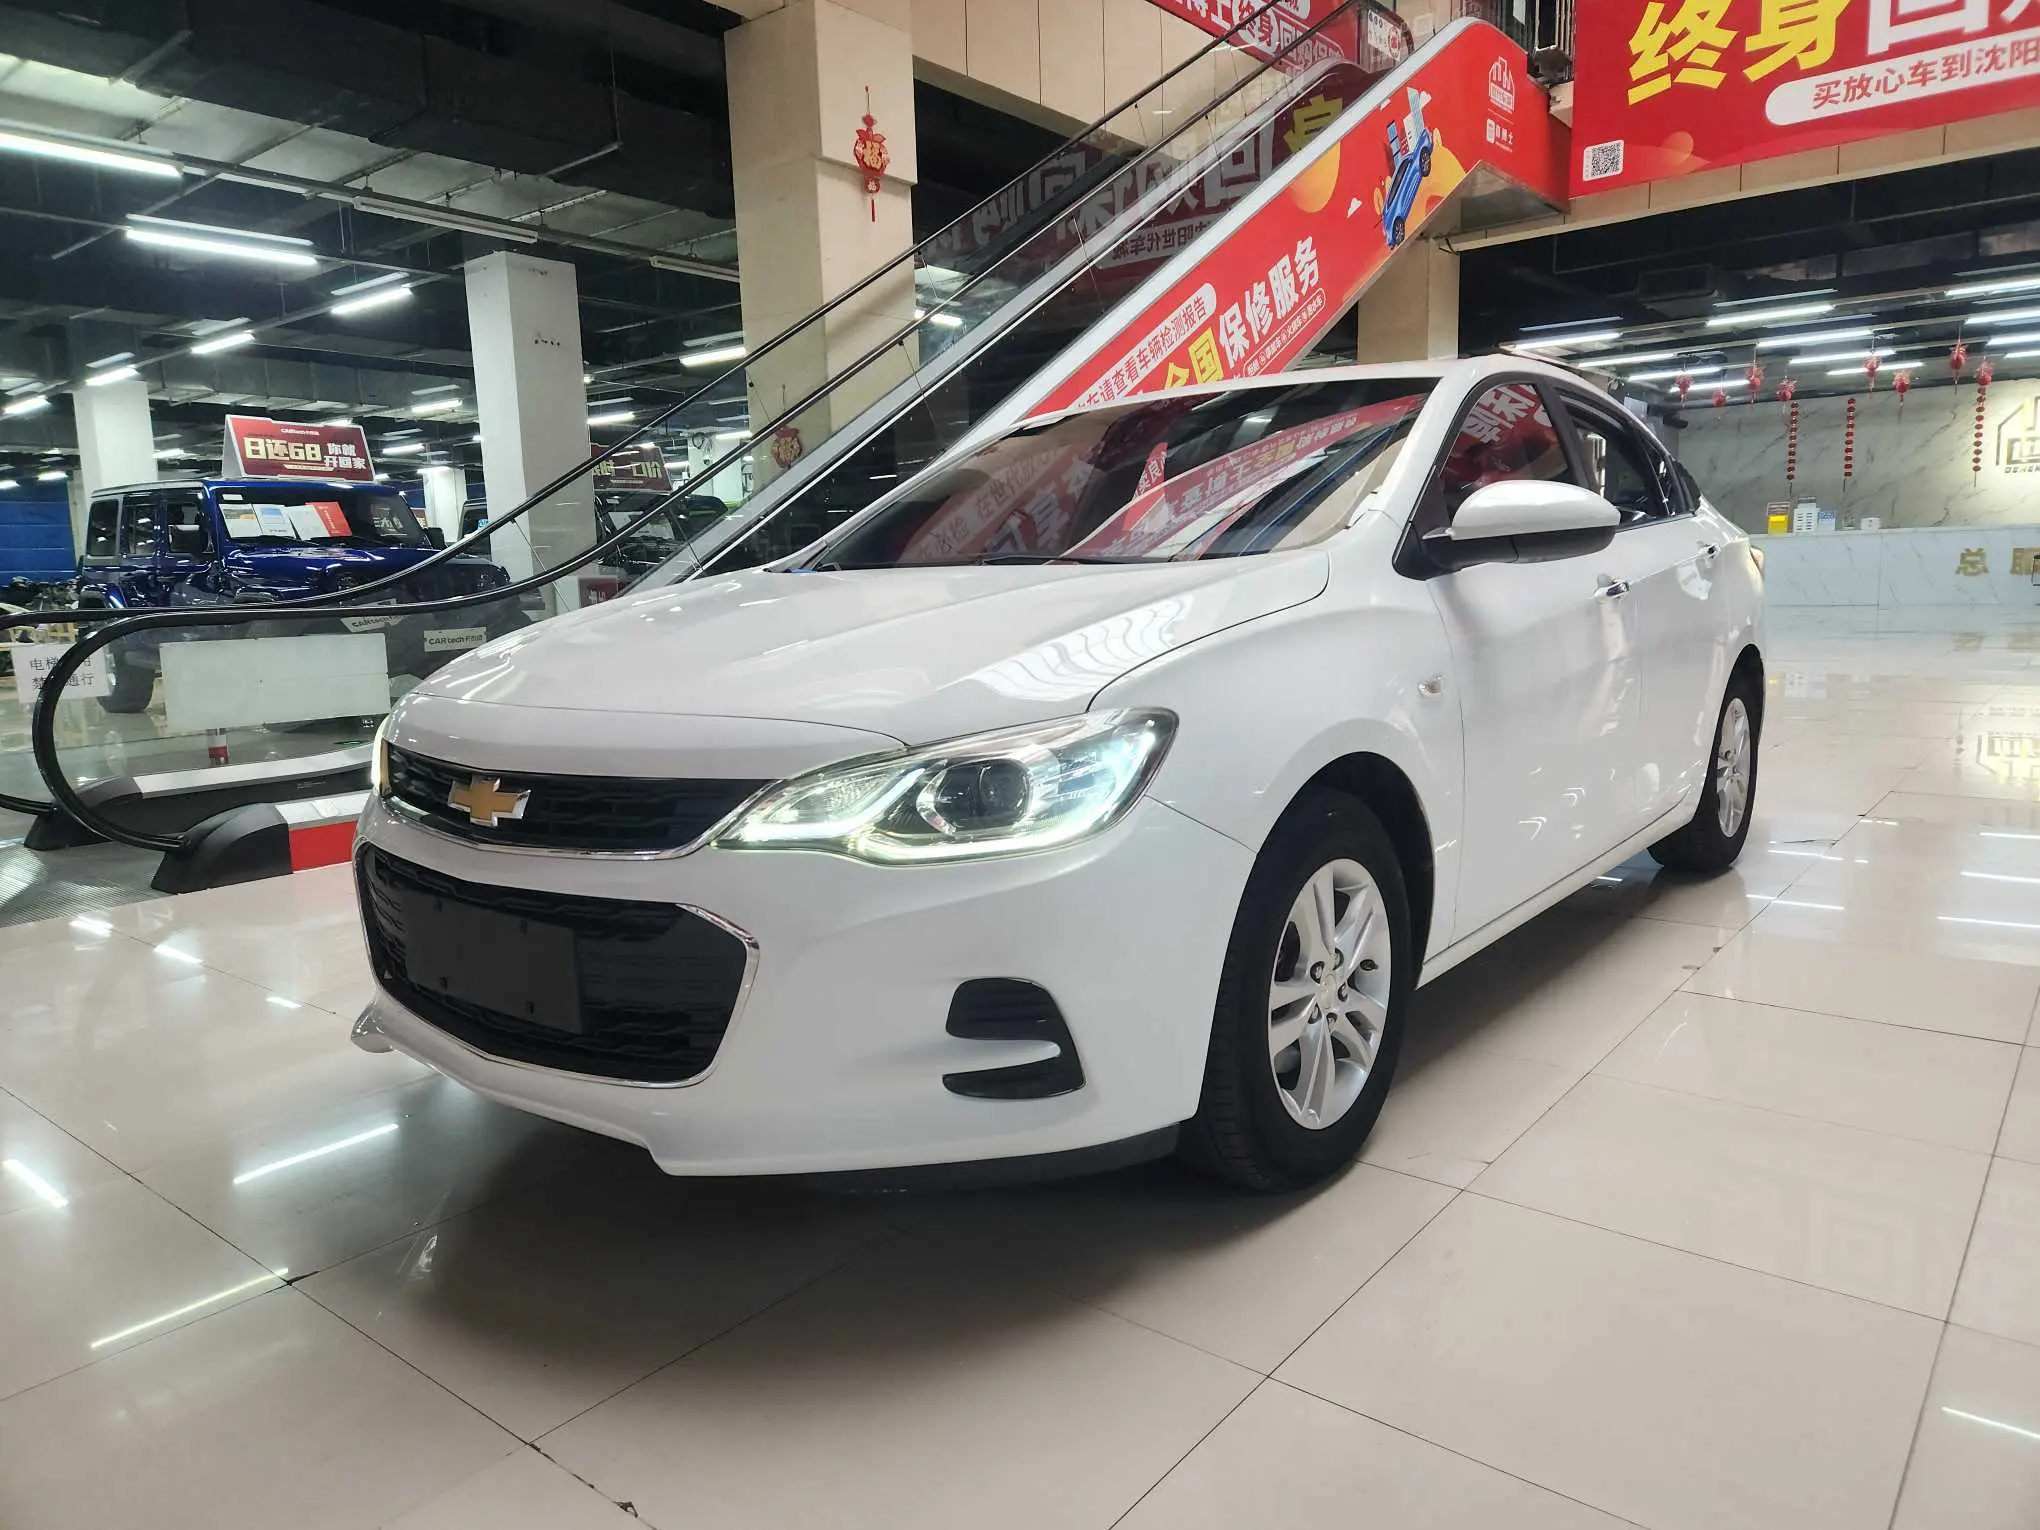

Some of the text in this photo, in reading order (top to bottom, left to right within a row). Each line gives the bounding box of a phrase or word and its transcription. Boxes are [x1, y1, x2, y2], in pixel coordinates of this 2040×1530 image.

[1812, 36, 2040, 110] 买放心车到沈阳
[243, 436, 322, 462] 日还68
[29, 655, 93, 671] 电梯
[31, 673, 94, 690] 禁通行
